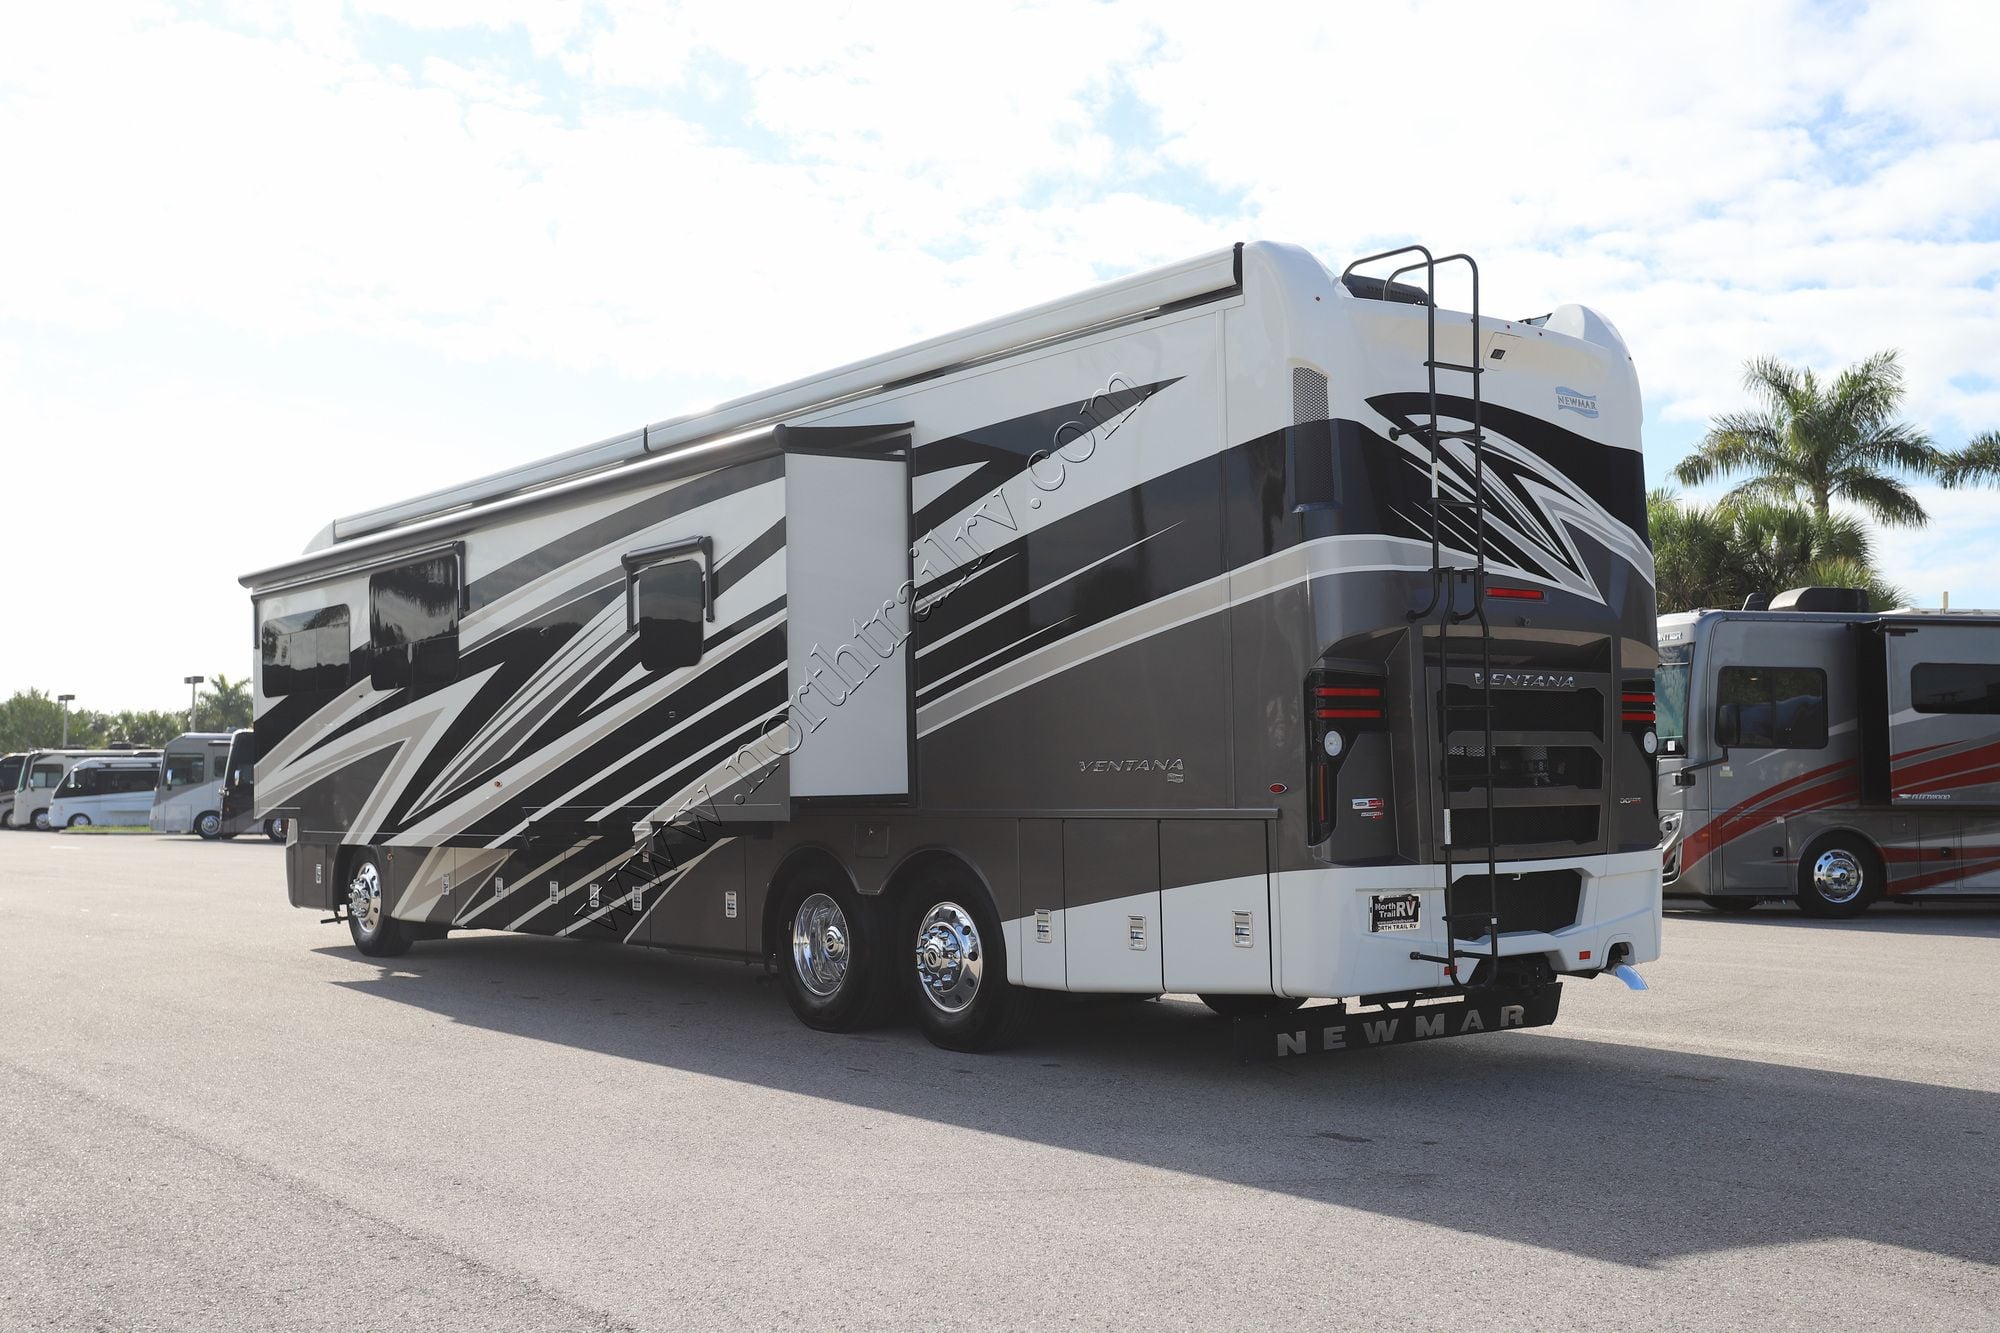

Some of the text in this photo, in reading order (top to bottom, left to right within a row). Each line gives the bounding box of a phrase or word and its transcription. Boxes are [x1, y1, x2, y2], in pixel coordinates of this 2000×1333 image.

[1557, 395, 1596, 409] NEWMAR
[1474, 672, 1575, 688] VENTANA
[1079, 758, 1184, 772] VENTANA
[1375, 902, 1396, 910] North
[1396, 901, 1416, 917] RV
[1379, 910, 1396, 918] Trail
[1276, 1004, 1525, 1057] NEWMAR
